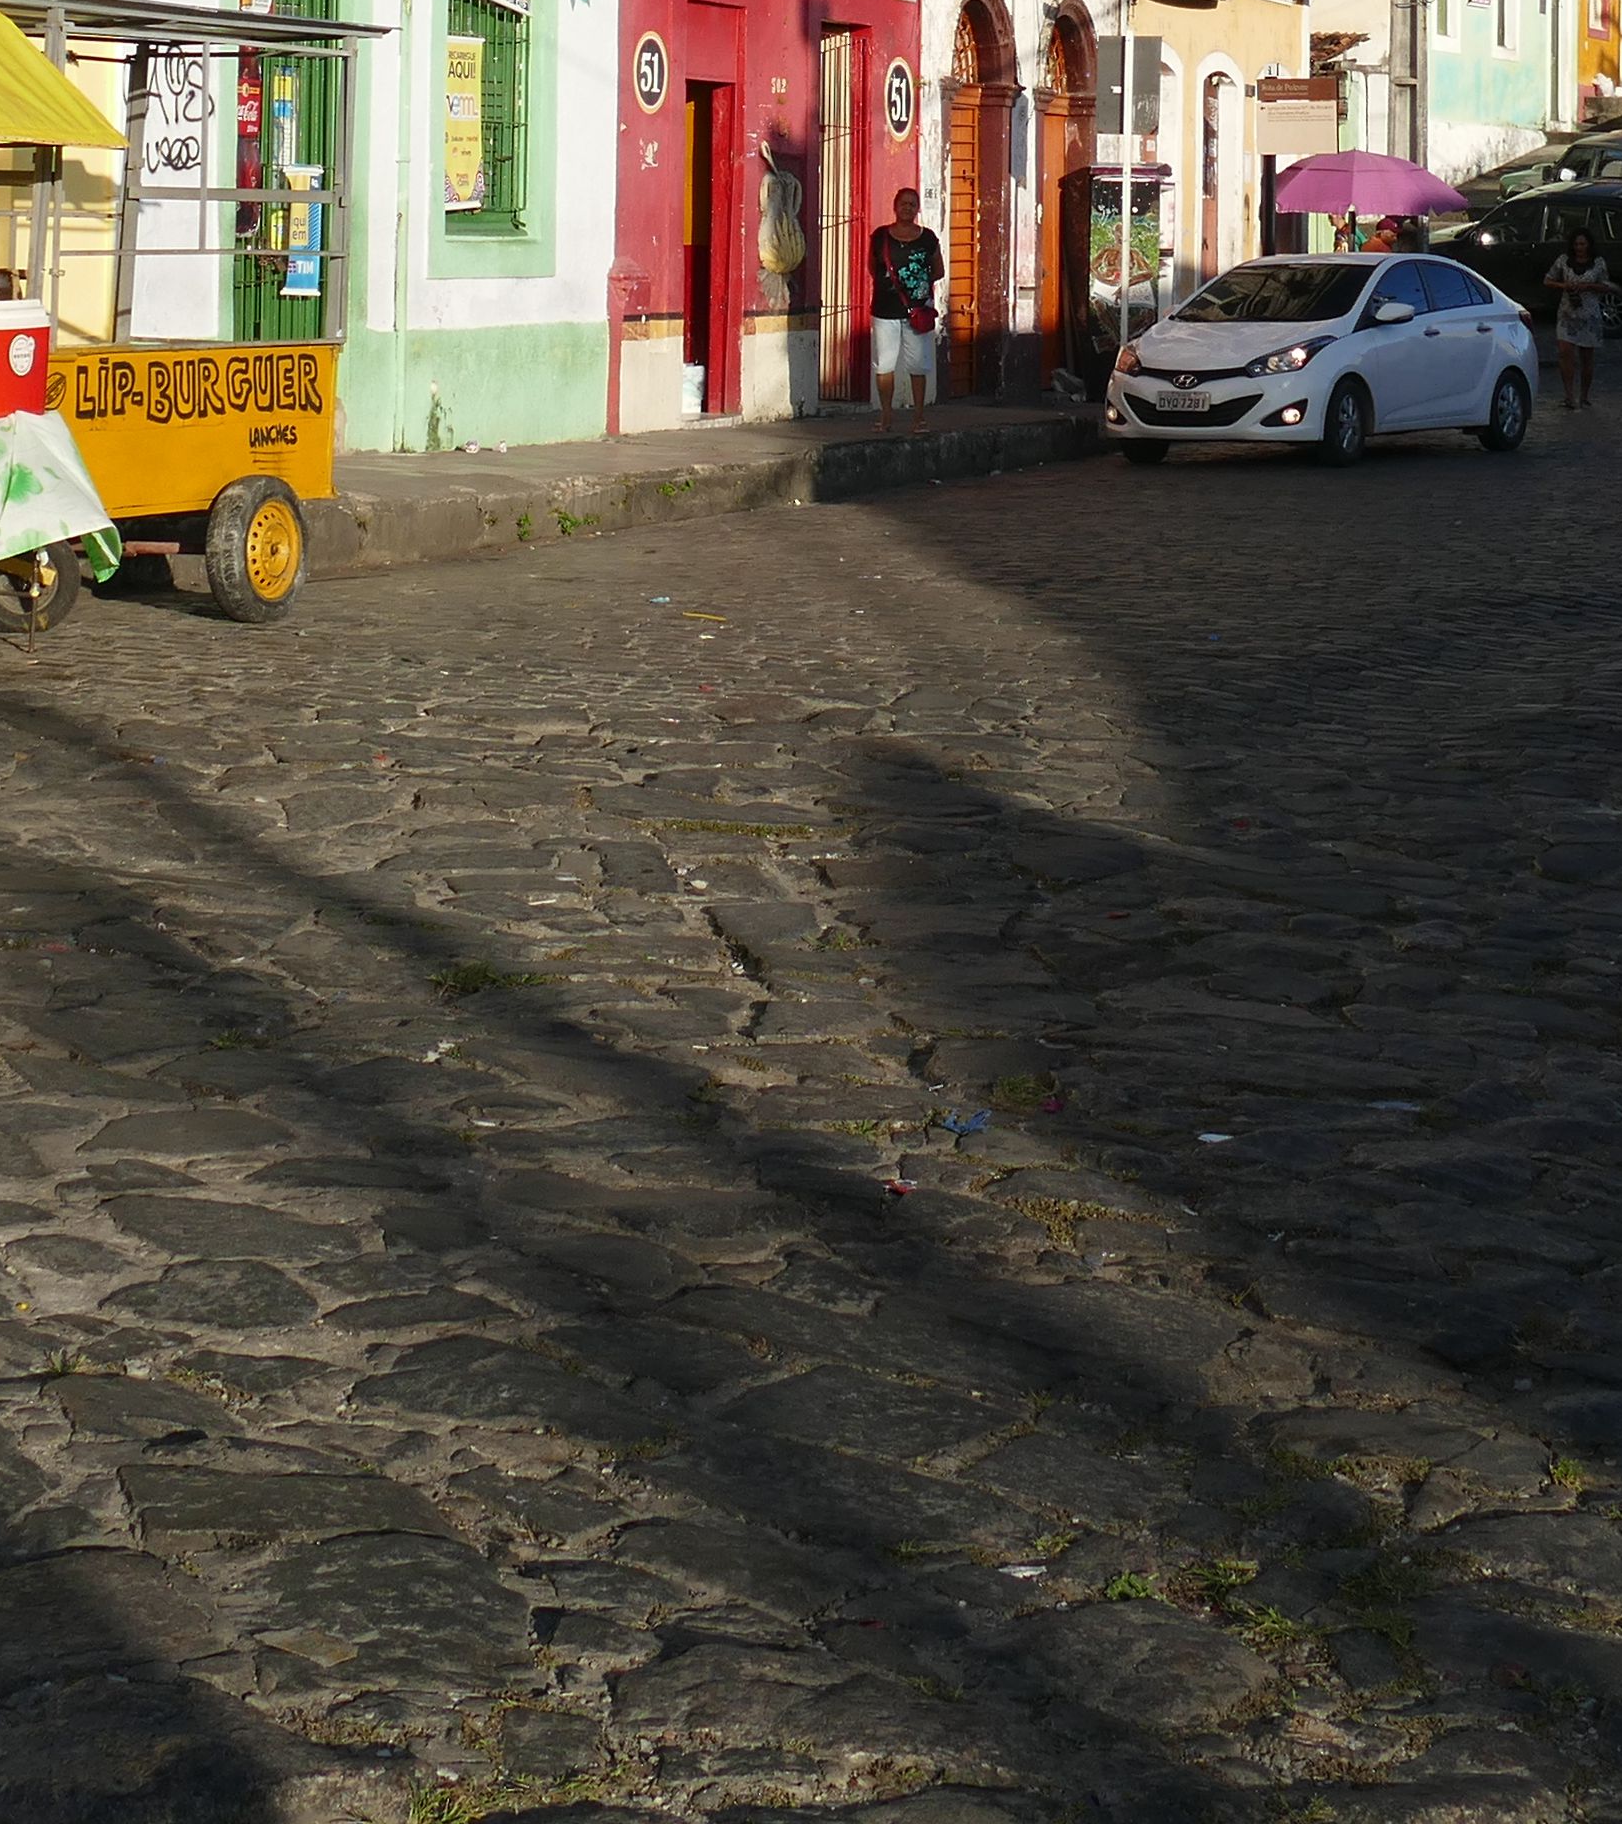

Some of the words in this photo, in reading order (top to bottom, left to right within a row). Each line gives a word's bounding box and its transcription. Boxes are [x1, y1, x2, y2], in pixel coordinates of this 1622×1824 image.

[640, 52, 660, 93] 51
[891, 78, 908, 122] 51
[298, 261, 314, 274] TIM
[249, 425, 298, 449] LANCHES
